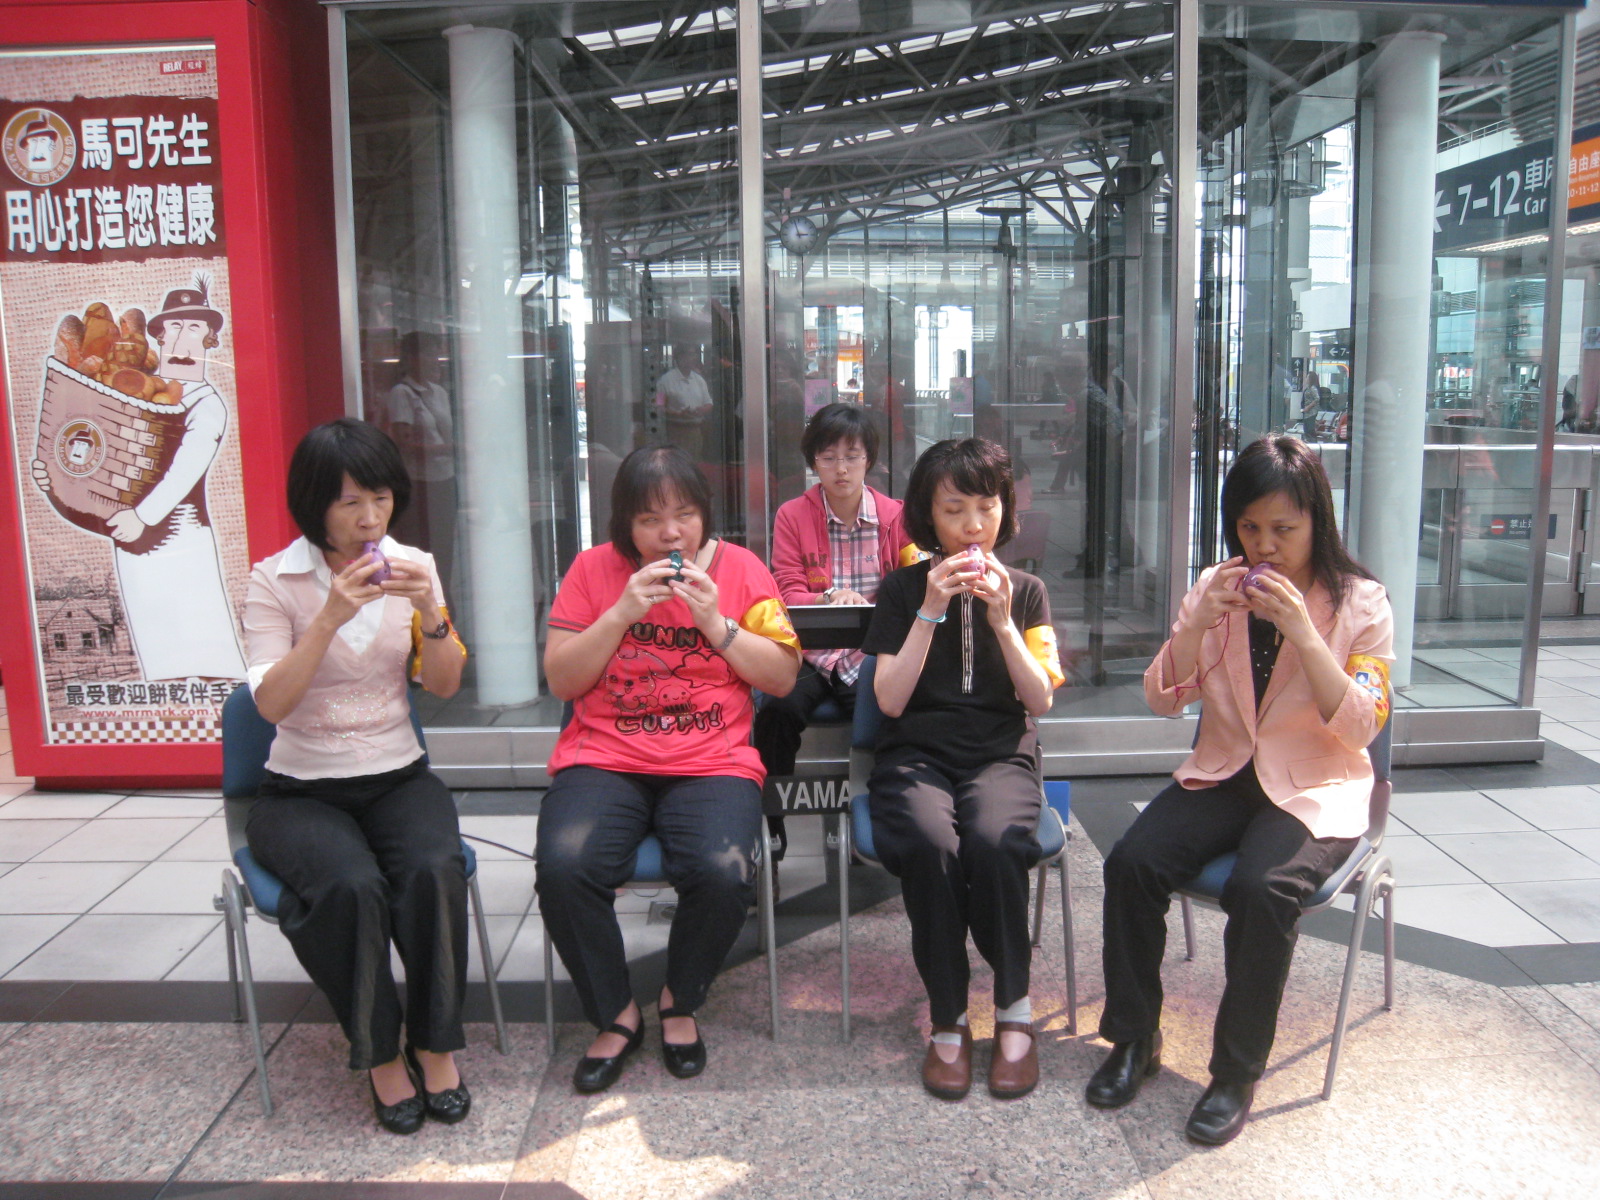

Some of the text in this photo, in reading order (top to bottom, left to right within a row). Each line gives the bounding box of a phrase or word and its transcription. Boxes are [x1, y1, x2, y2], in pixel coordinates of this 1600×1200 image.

[81, 112, 212, 170] 馬可先生
[5, 182, 217, 253] 用心打造您健康
[1457, 170, 1520, 226] 7-12
[1524, 197, 1547, 216] Car
[66, 682, 247, 706] 最受歡迎餅乾伴手
[775, 780, 849, 810] YAMA
